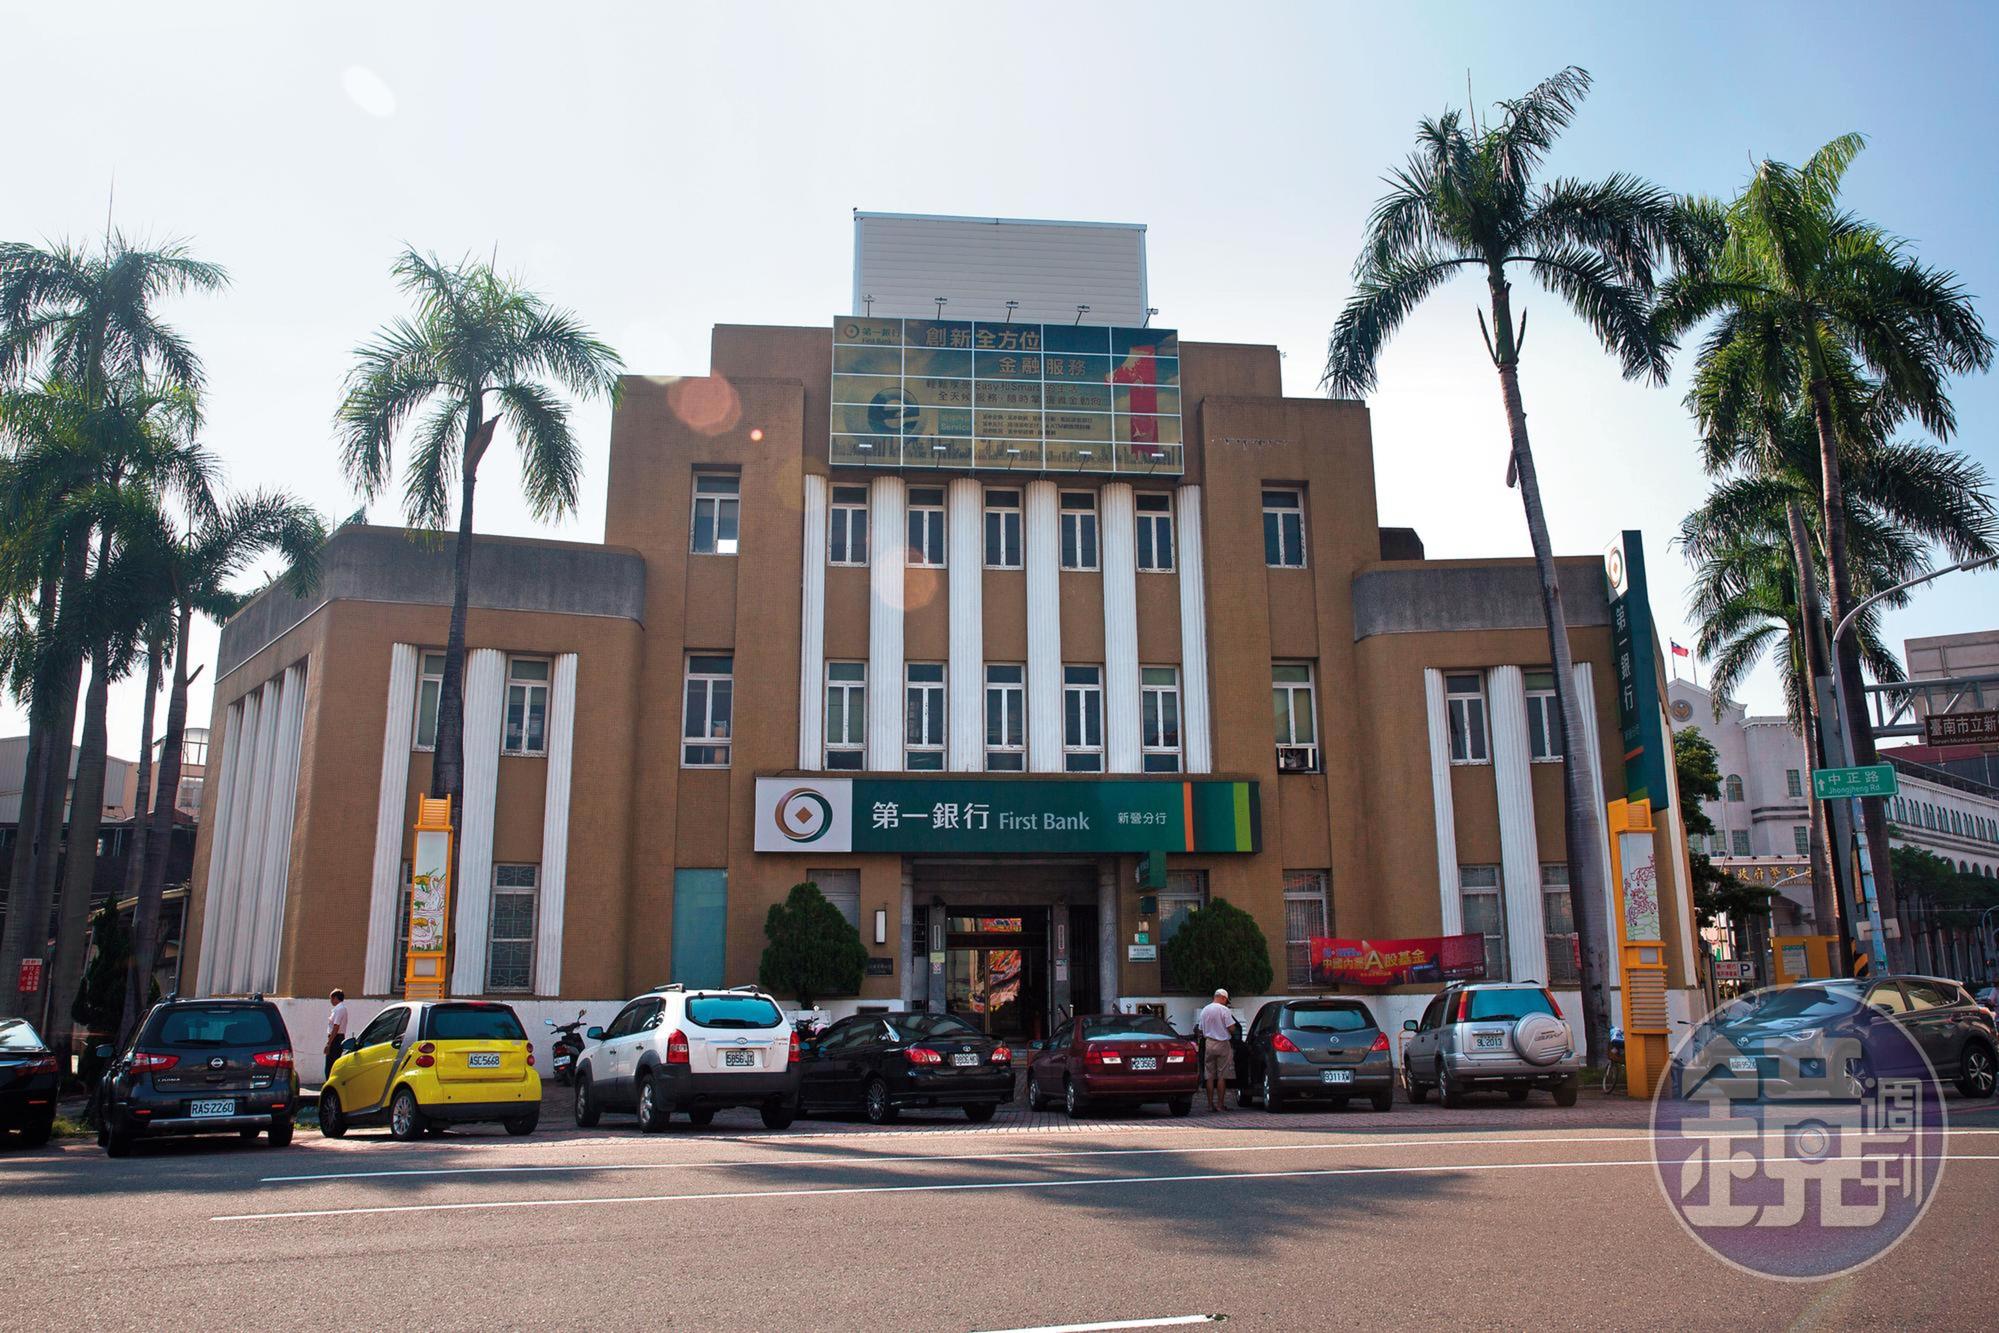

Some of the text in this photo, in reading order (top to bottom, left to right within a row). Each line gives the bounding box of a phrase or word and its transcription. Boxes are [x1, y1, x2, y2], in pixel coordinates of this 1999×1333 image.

[925, 327, 1041, 351] 創新全方位
[999, 356, 1087, 376] 金融服務
[1615, 604, 1634, 711] 第一銀行
[1929, 715, 1999, 737] 臺南市立新
[1828, 771, 1880, 786] 中正路
[1828, 785, 1869, 795] Jhongjheng
[872, 801, 990, 830] 第一銀行
[999, 811, 1090, 830] First Bank
[1117, 812, 1168, 825] 新營分行
[1740, 963, 1751, 977] P
[469, 1055, 500, 1066] ASC-5668
[191, 1102, 234, 1115] RAS-2260
